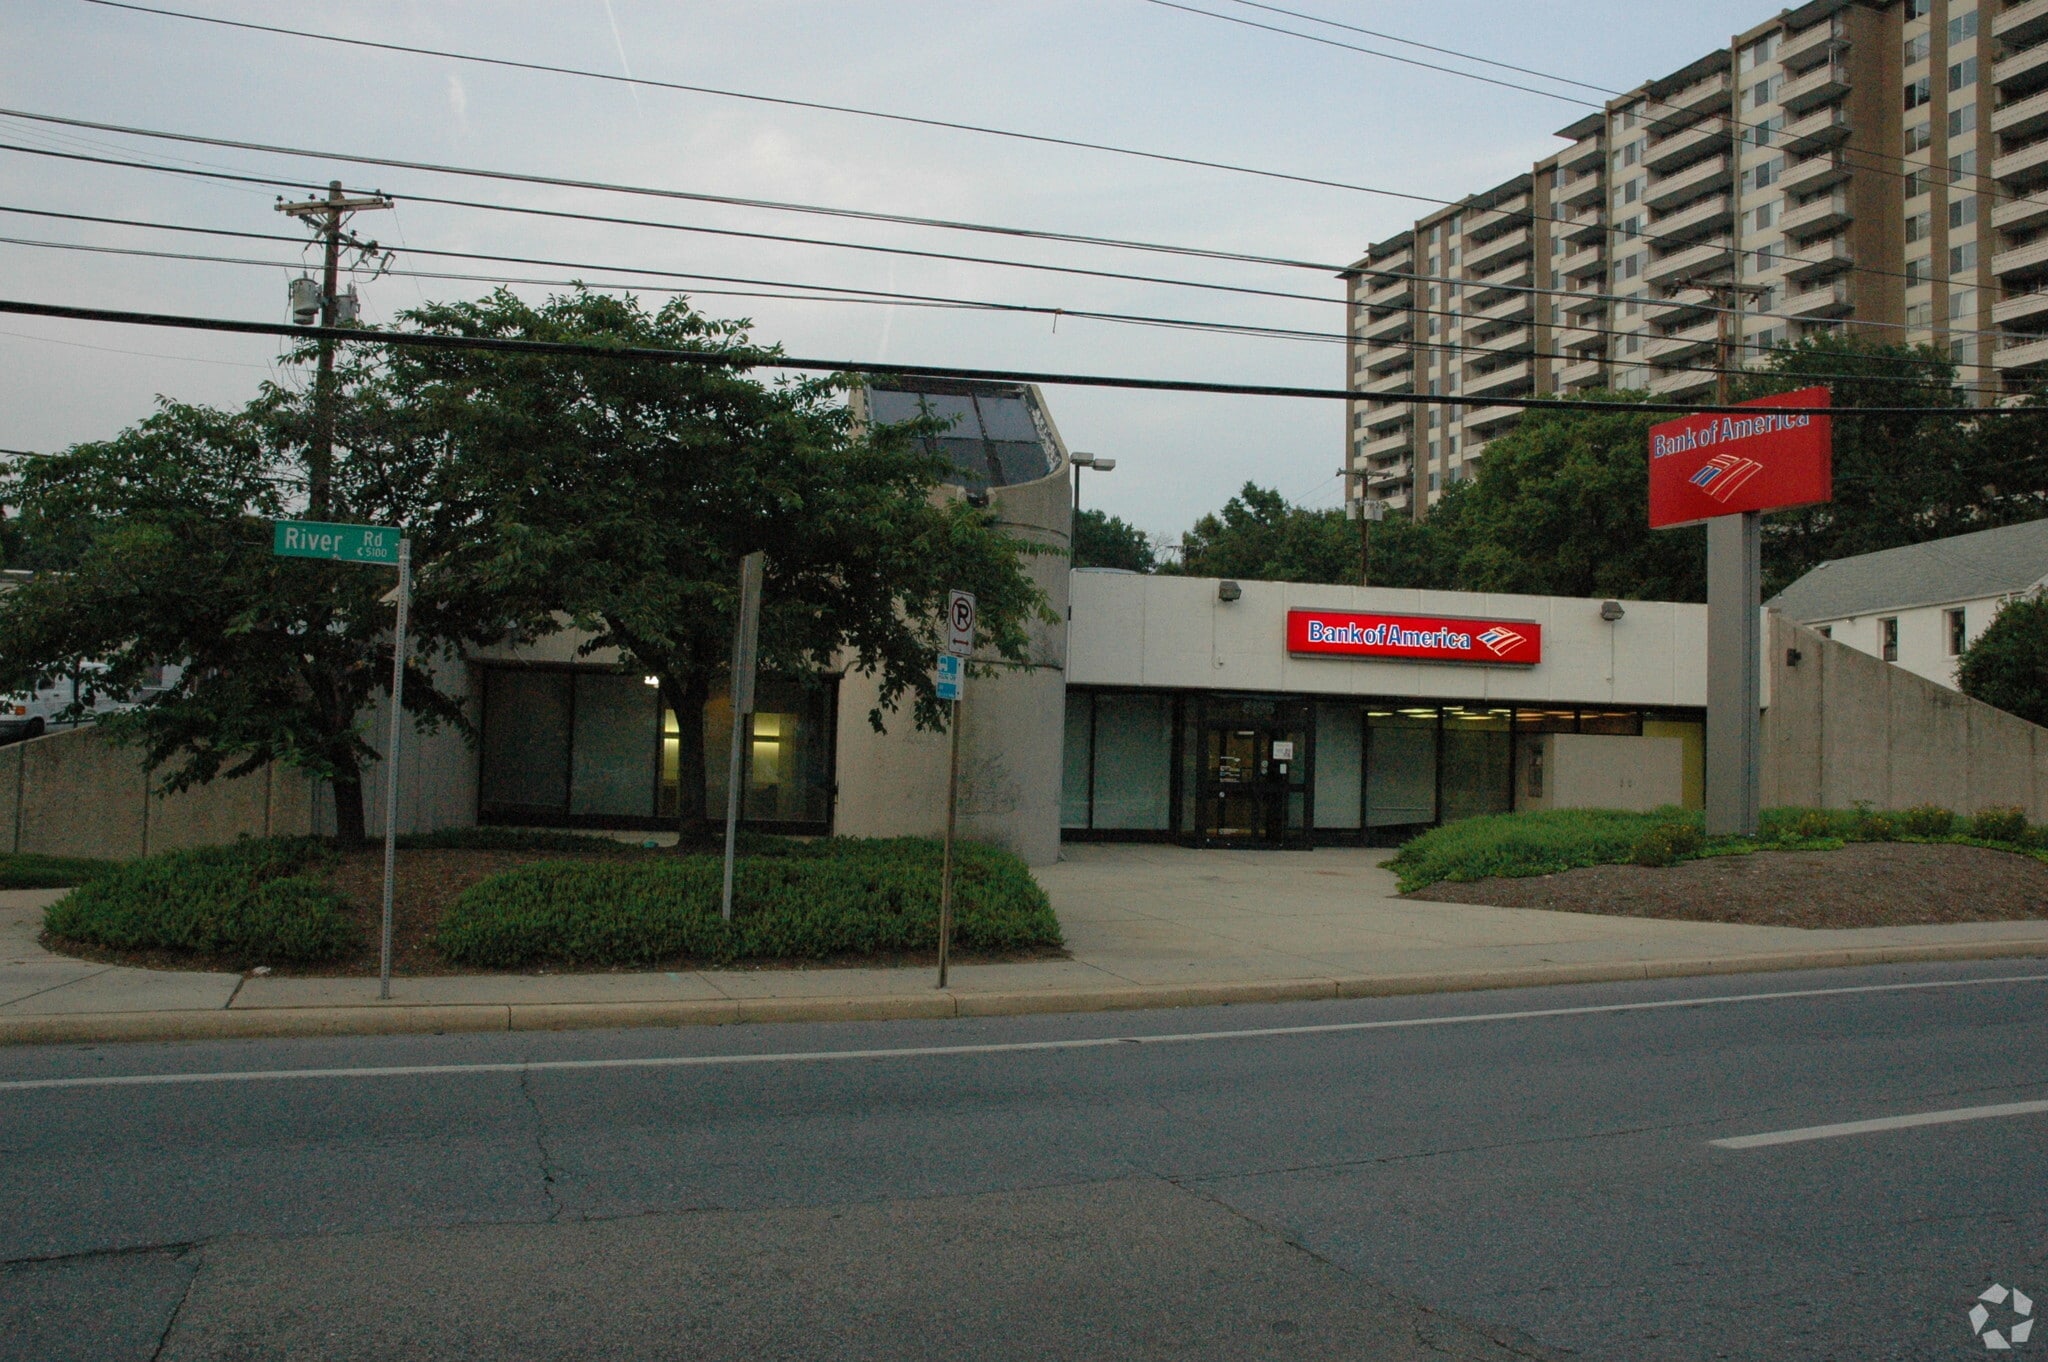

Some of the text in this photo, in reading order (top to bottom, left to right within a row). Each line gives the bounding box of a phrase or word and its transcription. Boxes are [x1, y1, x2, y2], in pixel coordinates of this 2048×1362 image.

[1653, 412, 1810, 459] Bank of America
[284, 526, 383, 553] River Rd
[365, 547, 388, 558] 5100
[1307, 620, 1472, 650] Bank of America
